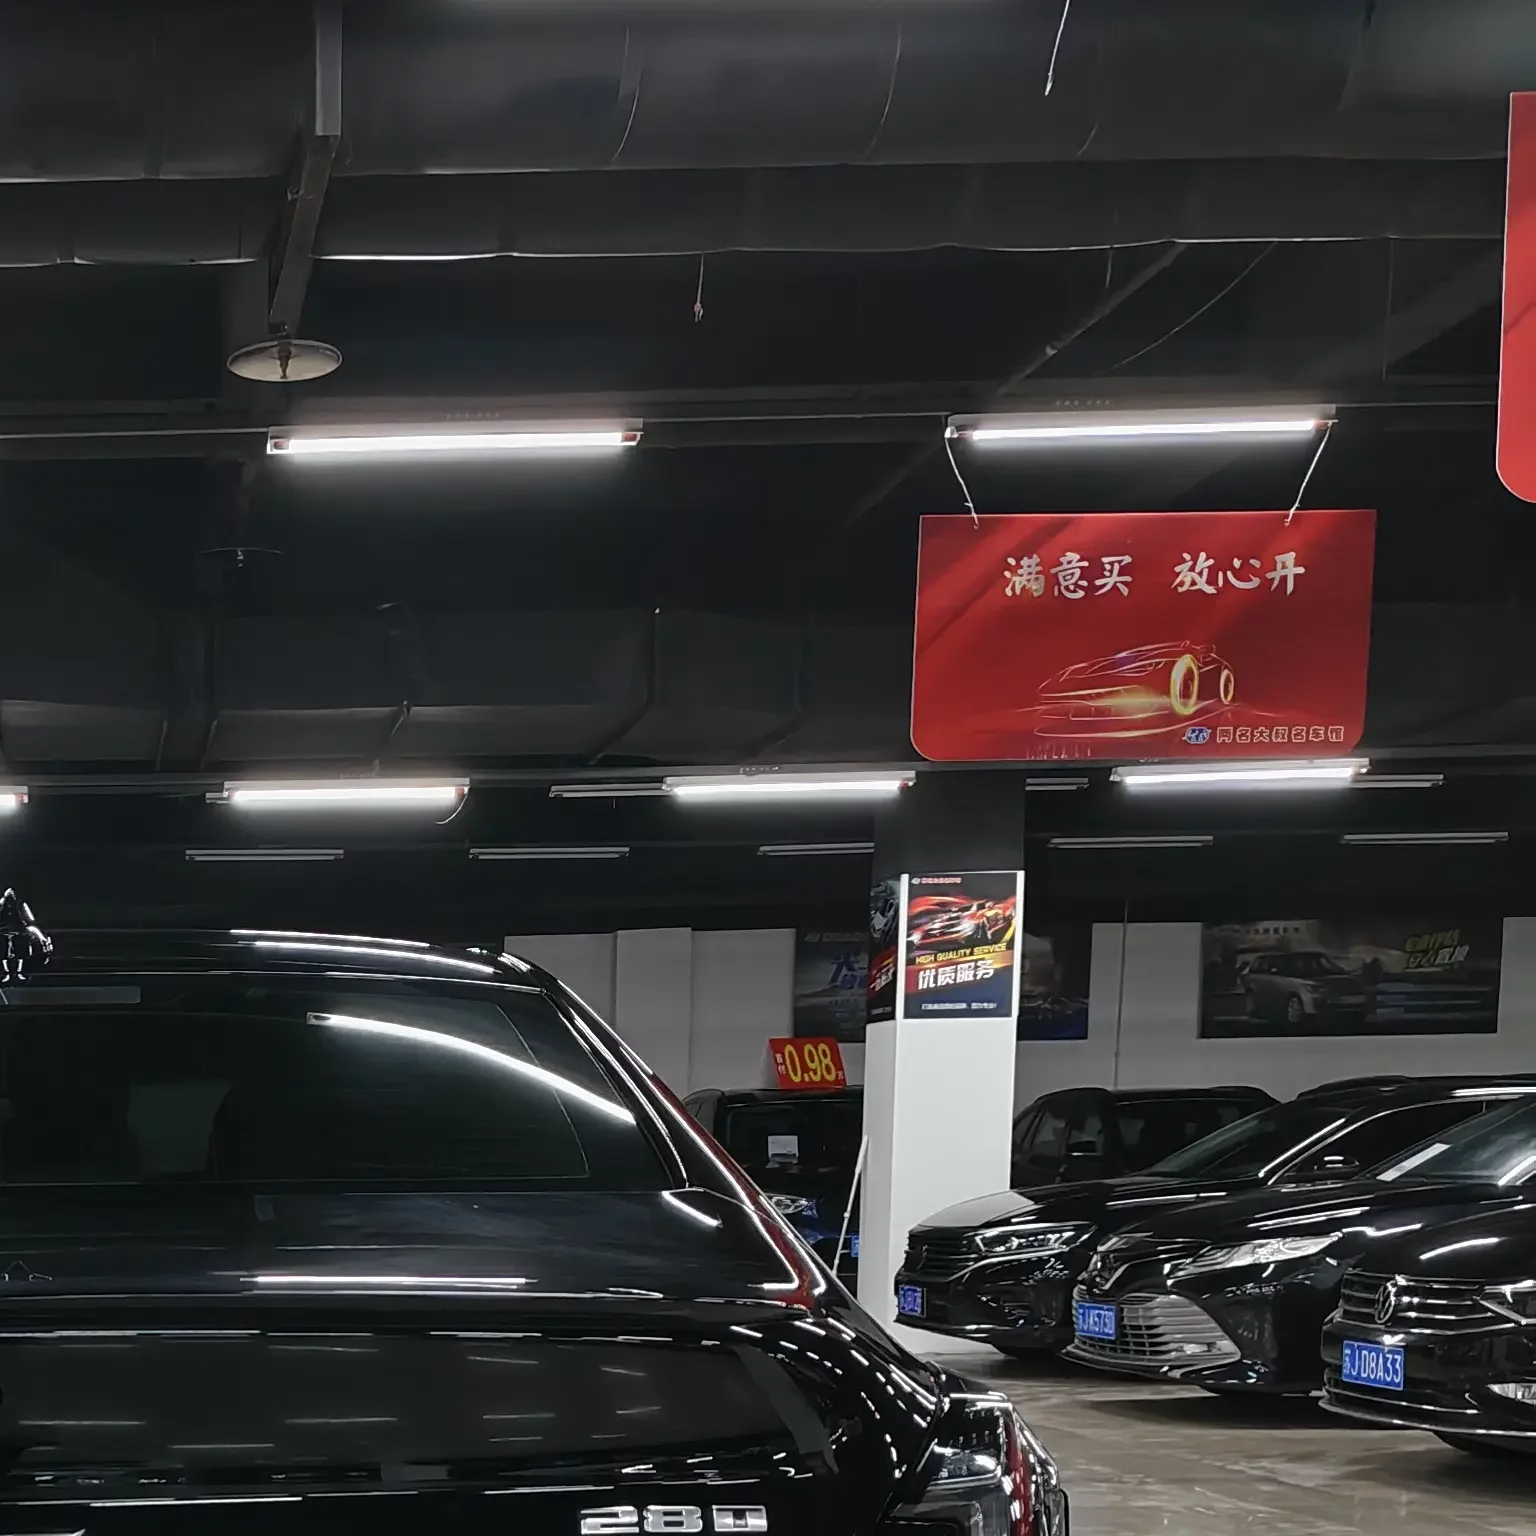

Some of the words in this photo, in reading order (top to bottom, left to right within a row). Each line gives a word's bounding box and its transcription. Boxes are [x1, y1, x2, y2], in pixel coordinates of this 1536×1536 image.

[1003, 551, 1133, 599] 满意买
[1170, 551, 1306, 597] 放心开
[1216, 726, 1345, 743] 两名大叔名车馆
[915, 954, 934, 964] HIGH
[936, 948, 972, 961] QUALITY
[973, 943, 1007, 956] SERVICE
[917, 959, 995, 990] 优质服务
[784, 1043, 836, 1082] 0.98
